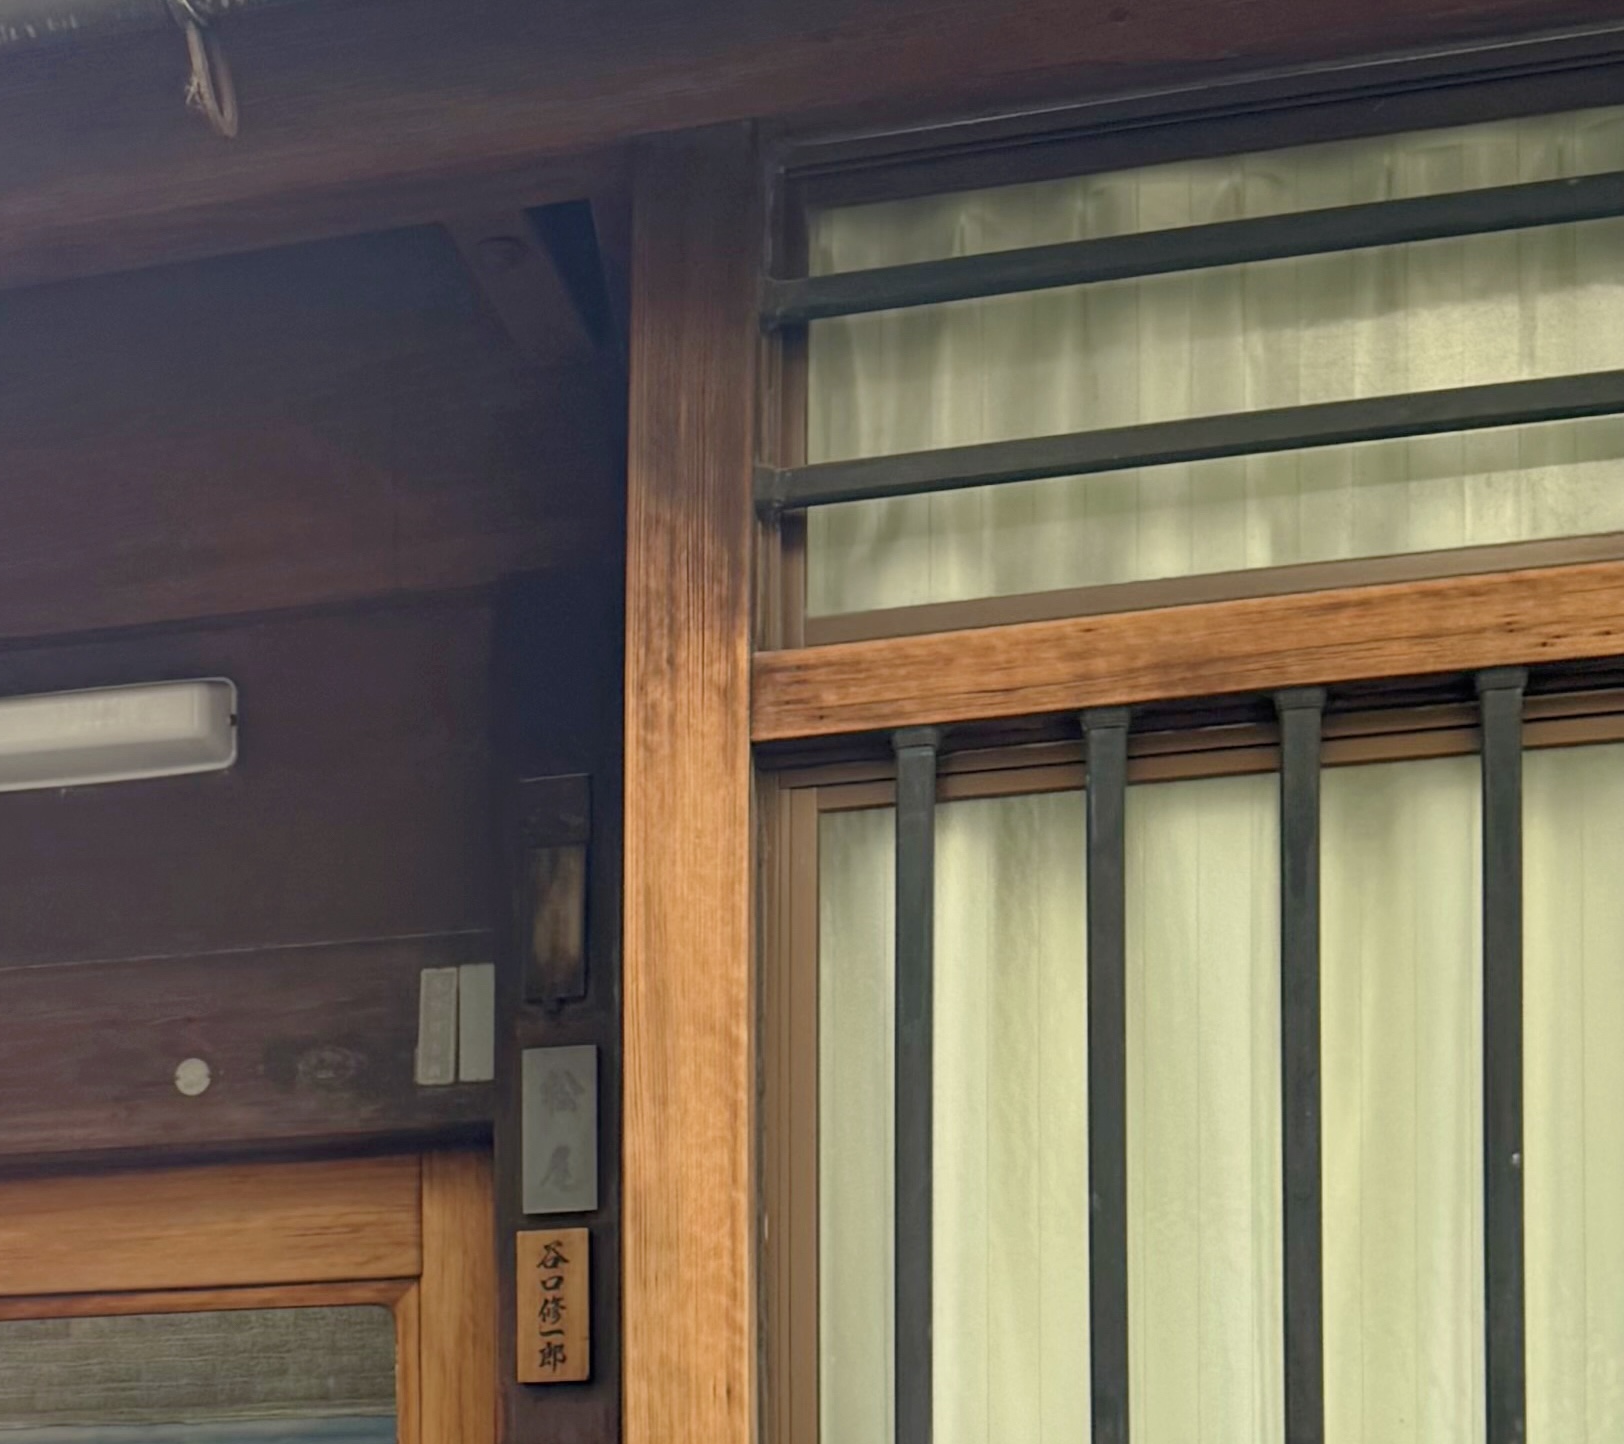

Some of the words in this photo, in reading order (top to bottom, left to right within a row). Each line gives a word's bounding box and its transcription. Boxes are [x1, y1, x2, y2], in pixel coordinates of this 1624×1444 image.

[536, 1239, 570, 1374] 谷口修一郎
